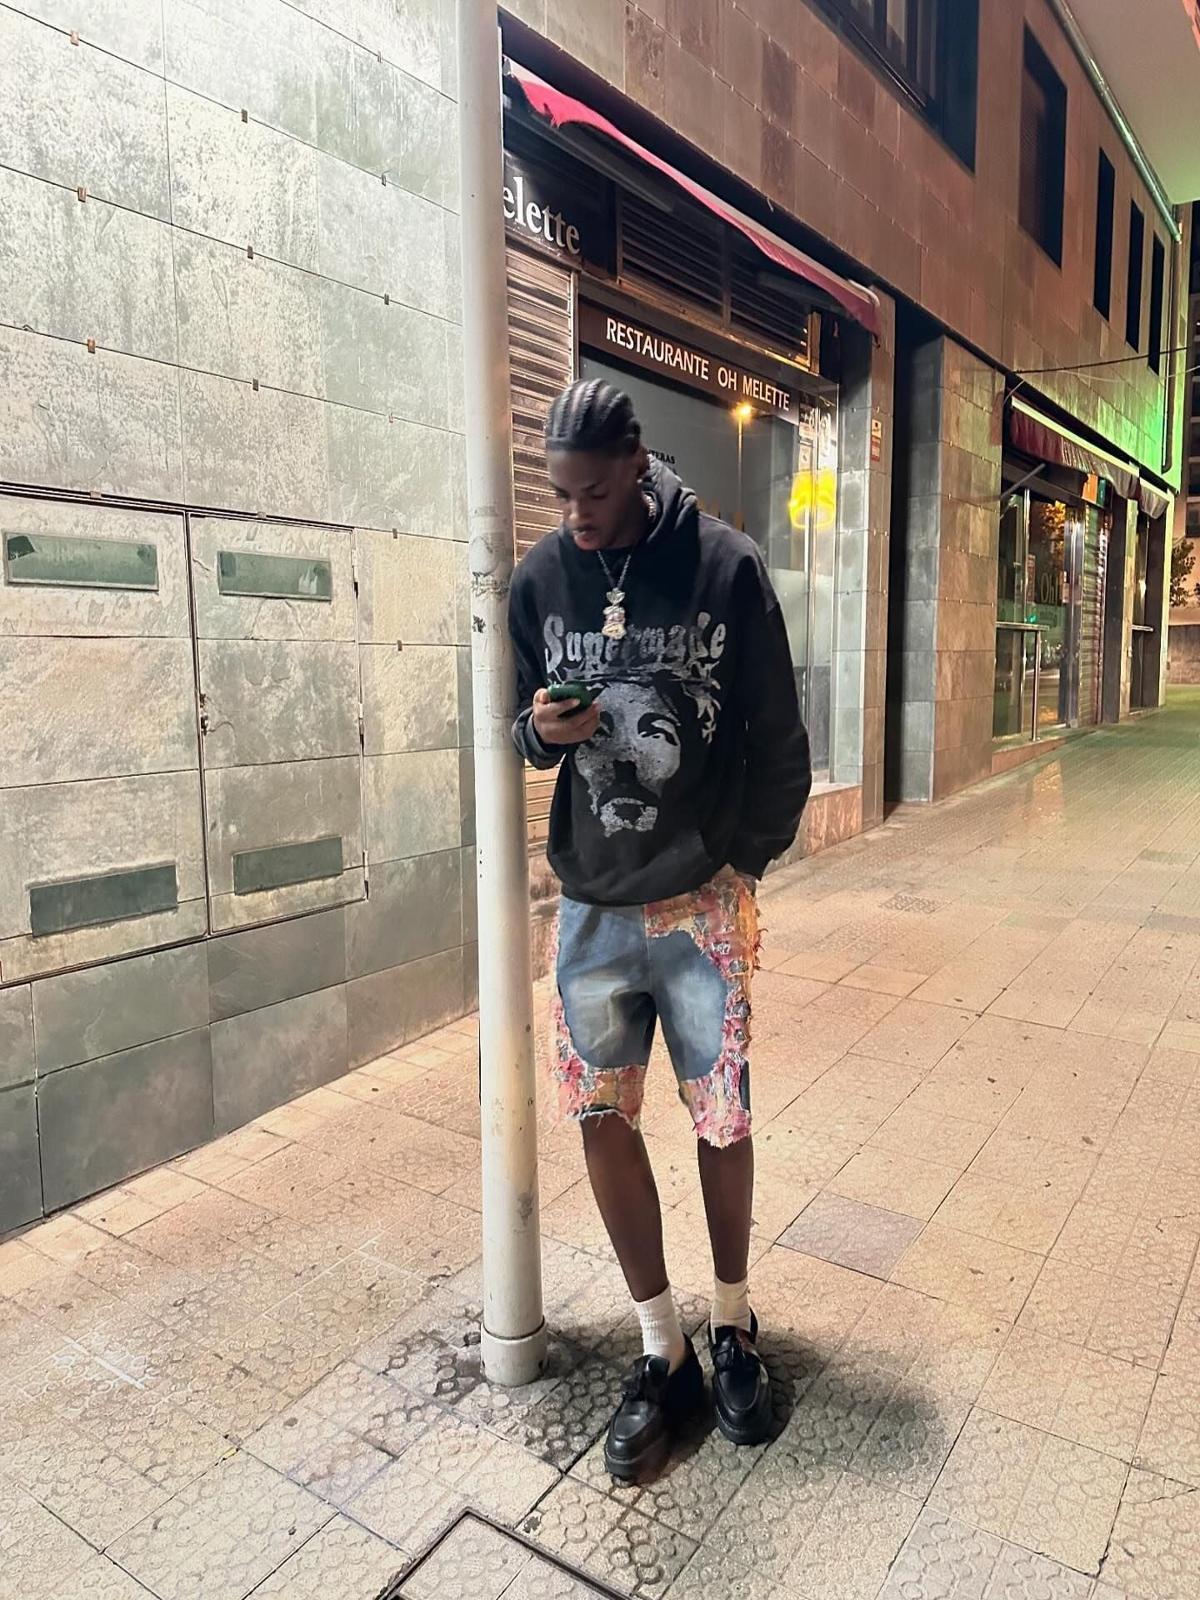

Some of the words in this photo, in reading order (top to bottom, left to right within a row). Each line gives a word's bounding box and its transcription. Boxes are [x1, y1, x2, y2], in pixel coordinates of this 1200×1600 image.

[606, 317, 710, 381] RESTAURANTE
[717, 367, 738, 391] OH
[742, 375, 790, 412] MELETTE
